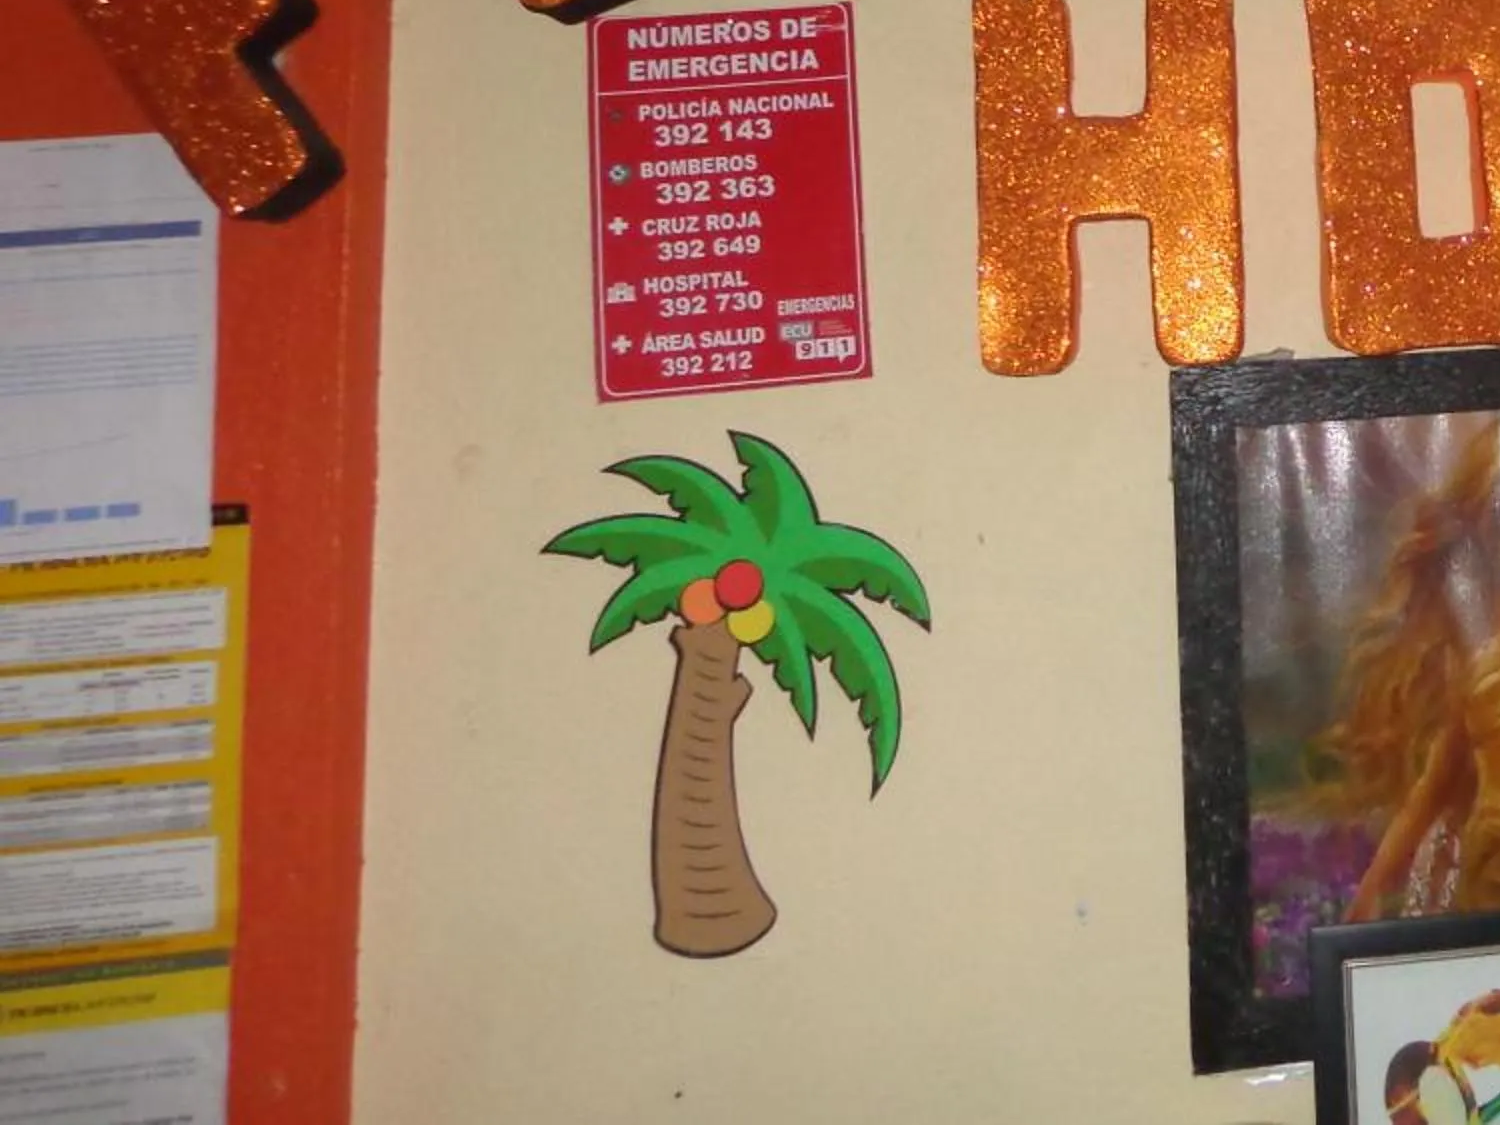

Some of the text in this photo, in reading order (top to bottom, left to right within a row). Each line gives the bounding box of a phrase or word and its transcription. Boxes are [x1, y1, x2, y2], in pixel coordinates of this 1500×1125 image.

[627, 17, 819, 50] NÚMEROS DE
[627, 48, 820, 83] EMERGENCIA
[638, 91, 834, 122] POLICÍA NACIONAL
[654, 117, 773, 148] 392 143
[639, 154, 758, 179] BOMBEROS
[655, 175, 776, 205] 392 363
[641, 210, 763, 236] CRUZ ROJA
[656, 233, 763, 262] 392 649
[643, 270, 749, 295] HOSPITAL
[659, 289, 765, 318] 392 730
[641, 326, 766, 355] ÁREA SALUD
[798, 338, 853, 358] 911
[660, 350, 754, 378] 392 212
